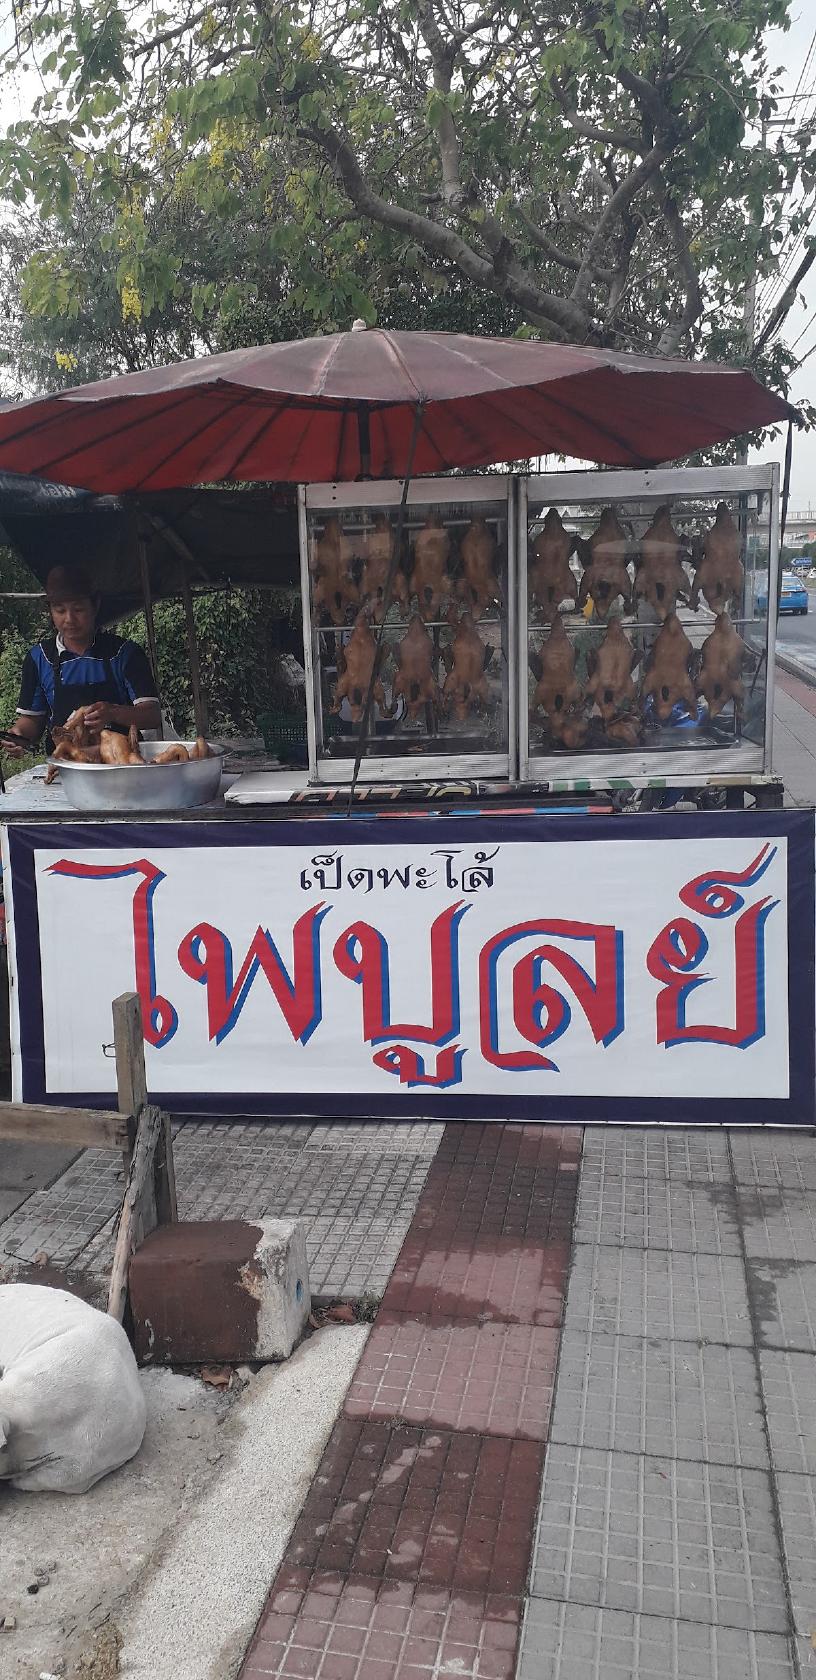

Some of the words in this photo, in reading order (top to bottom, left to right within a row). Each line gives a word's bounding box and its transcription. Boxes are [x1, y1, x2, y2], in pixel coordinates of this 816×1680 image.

[300, 846, 500, 894] เป็ดพะโล้
[42, 842, 778, 1088] ไพบูลย์
